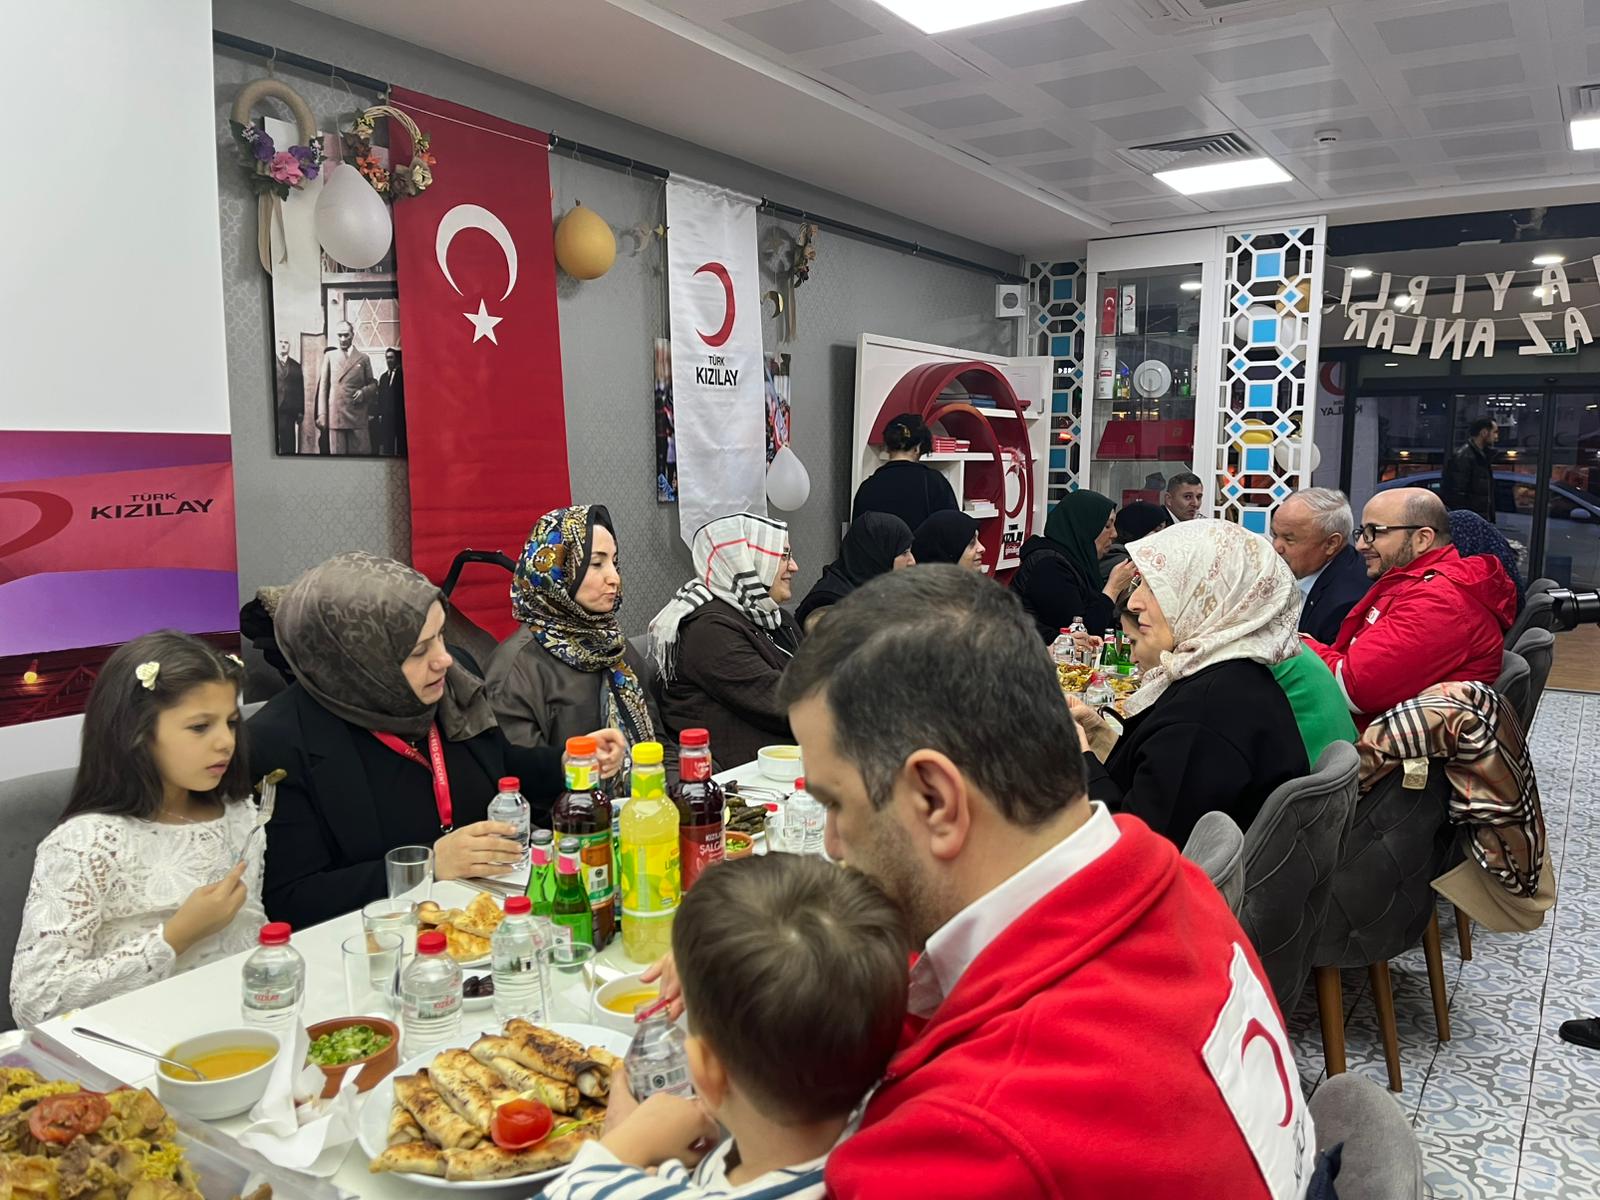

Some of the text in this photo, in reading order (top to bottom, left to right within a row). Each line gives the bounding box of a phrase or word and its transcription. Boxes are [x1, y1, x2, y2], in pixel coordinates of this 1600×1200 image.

[708, 354, 725, 366] TÜRK
[696, 366, 739, 386] KIZILAY
[131, 493, 177, 502] TÜRK
[90, 498, 214, 520] KIZILAY
